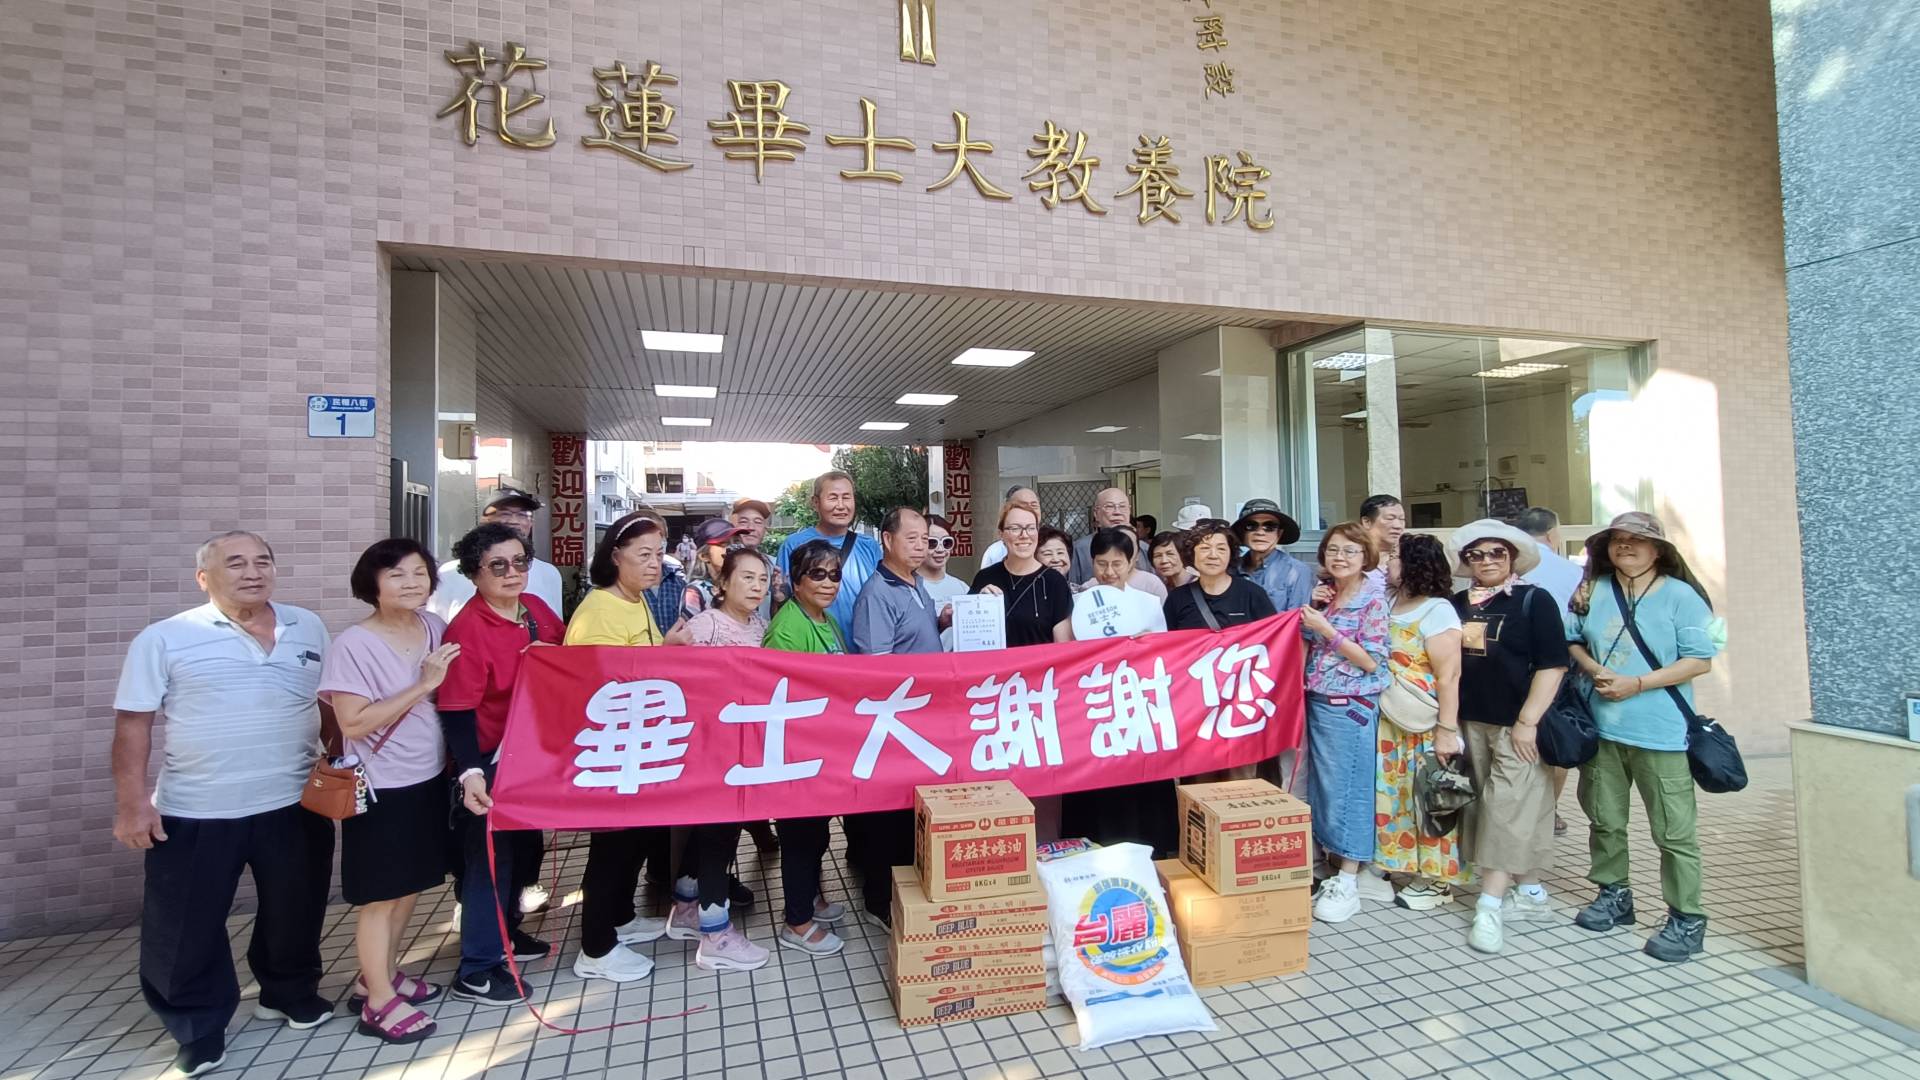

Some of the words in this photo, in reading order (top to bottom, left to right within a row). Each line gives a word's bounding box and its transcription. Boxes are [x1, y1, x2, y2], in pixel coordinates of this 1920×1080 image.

[1182, 0, 1235, 100] 附設
[436, 41, 1275, 231] 花蓮畢士大教養院
[336, 413, 346, 436] 1
[551, 434, 585, 567] 歡迎光臨
[945, 444, 973, 557] 歡迎光臨
[573, 642, 1278, 795] 畢士大謝謝您
[950, 838, 1022, 862] 香菇素蠔油
[938, 922, 955, 935] DEEP
[957, 918, 975, 931] BLUE
[933, 963, 950, 976] DEEP
[952, 959, 970, 972] BLUE
[936, 1005, 953, 1018] DEEP
[955, 999, 973, 1013] BLUE
